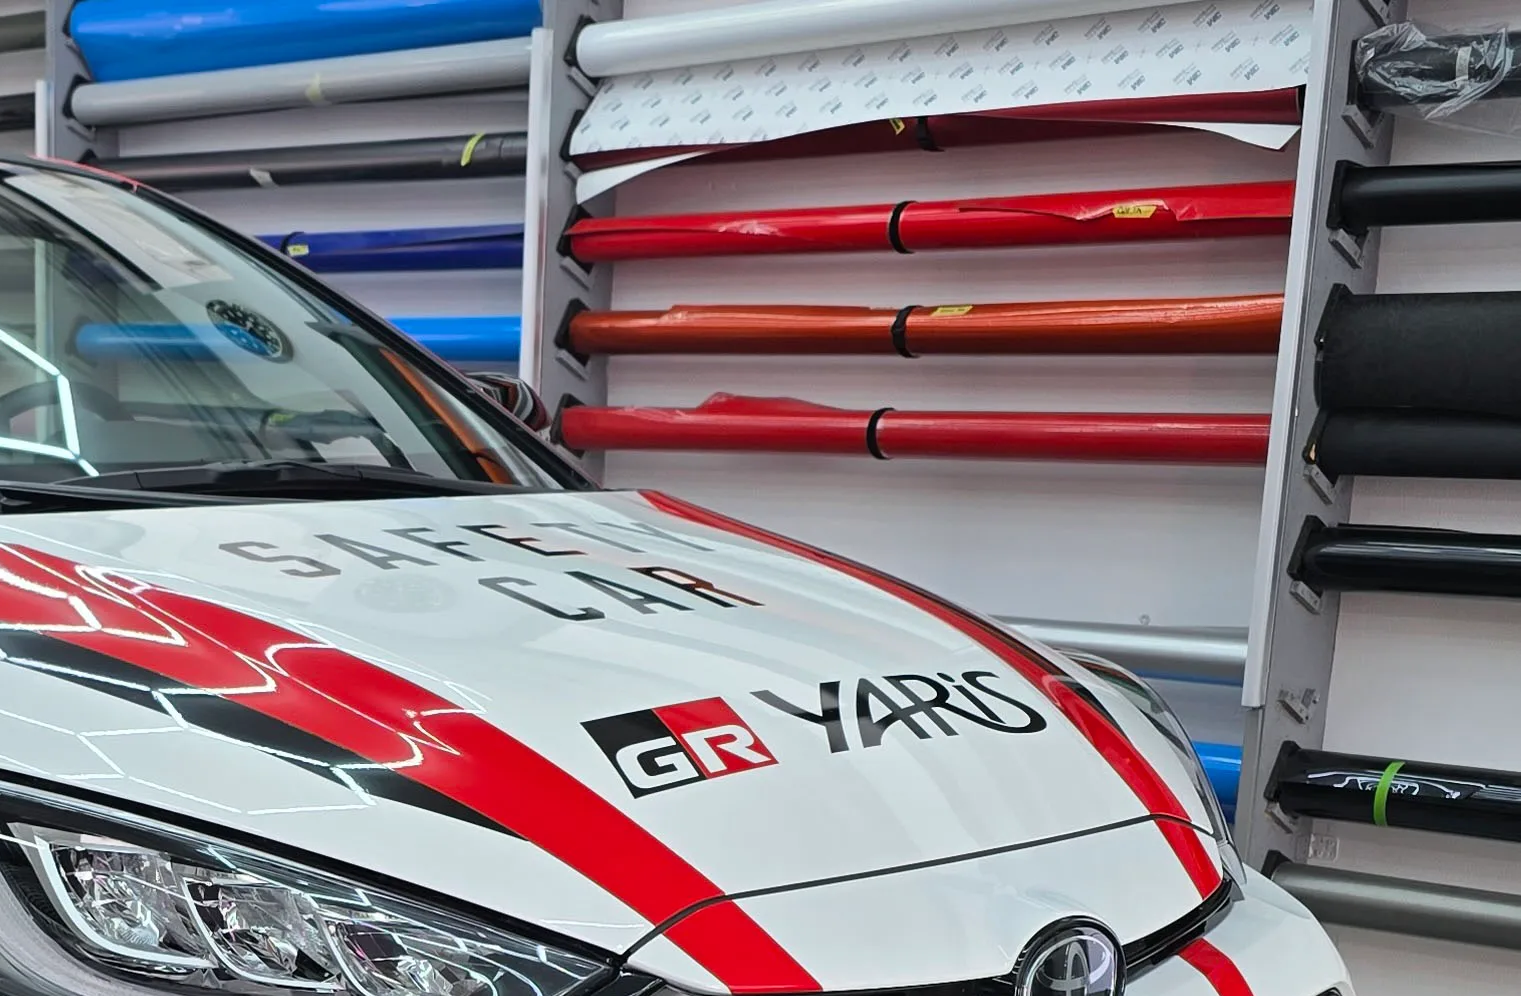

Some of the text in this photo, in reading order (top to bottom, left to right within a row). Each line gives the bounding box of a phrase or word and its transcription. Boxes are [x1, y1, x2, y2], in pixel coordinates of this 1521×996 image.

[218, 522, 715, 578] SAFETY
[478, 566, 764, 621] CAR
[616, 724, 771, 790] GR
